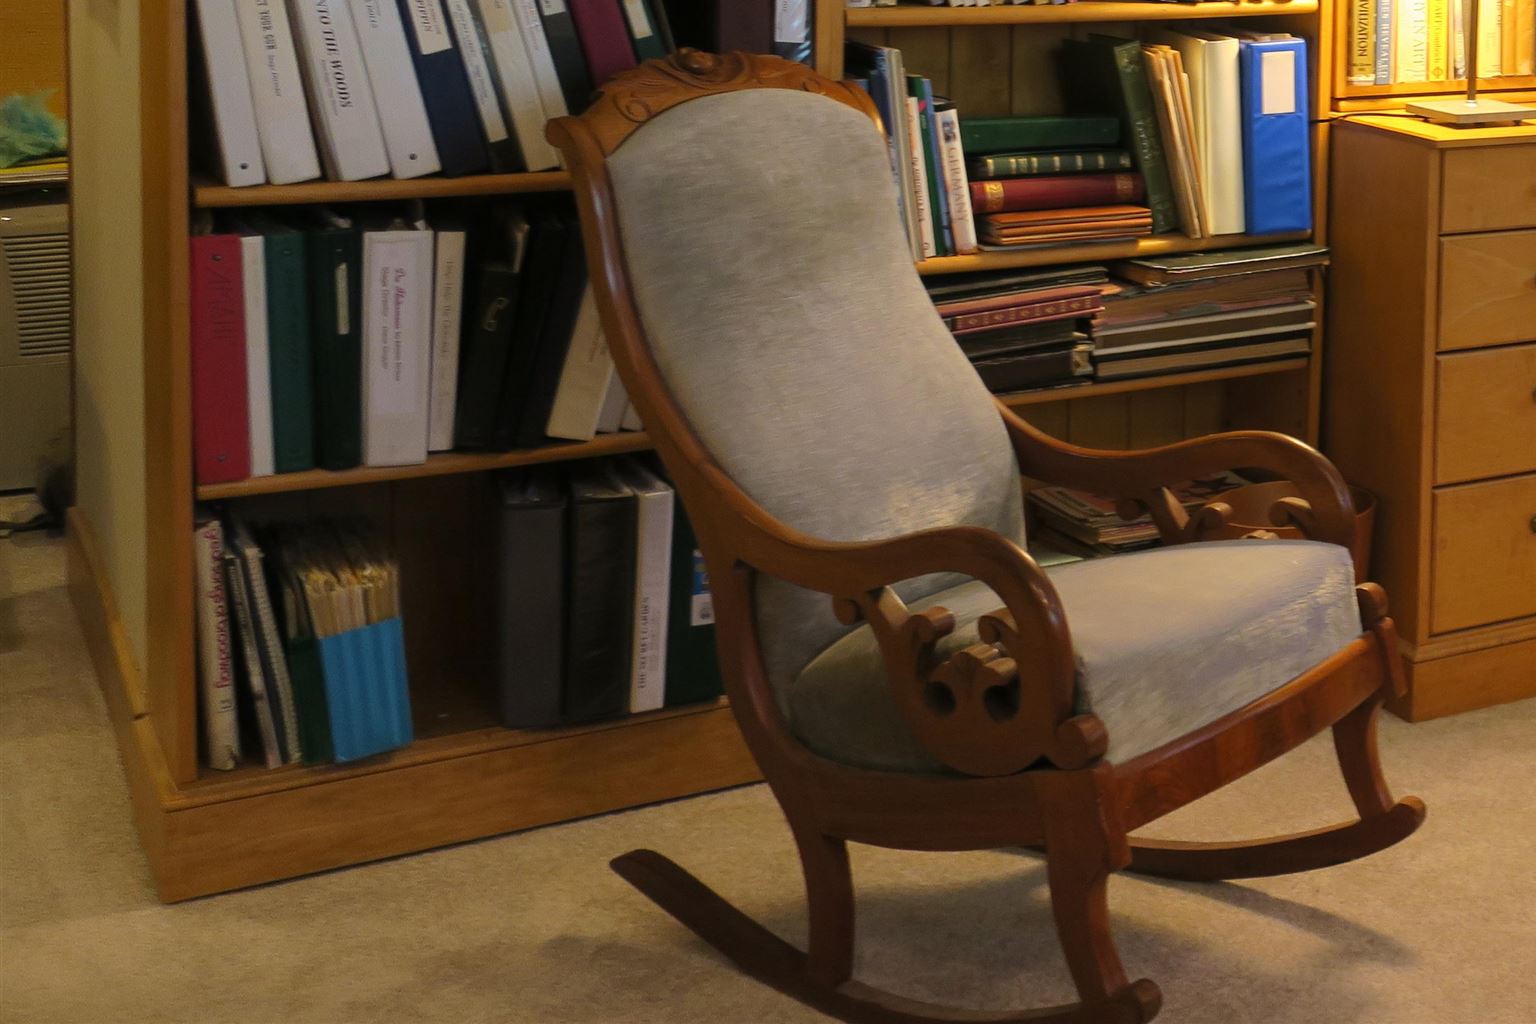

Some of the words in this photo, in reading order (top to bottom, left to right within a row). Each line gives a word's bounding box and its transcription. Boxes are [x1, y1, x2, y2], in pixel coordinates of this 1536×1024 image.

[257, 9, 275, 30] YOUR
[1434, 5, 1442, 23] ART
[260, 32, 277, 49] GUN
[1414, 19, 1424, 39] IN
[324, 27, 341, 55] THE
[1380, 23, 1390, 79] REVEALED
[1413, 43, 1424, 66] ART
[329, 58, 354, 107] WOODS
[948, 146, 970, 222] GERMANY
